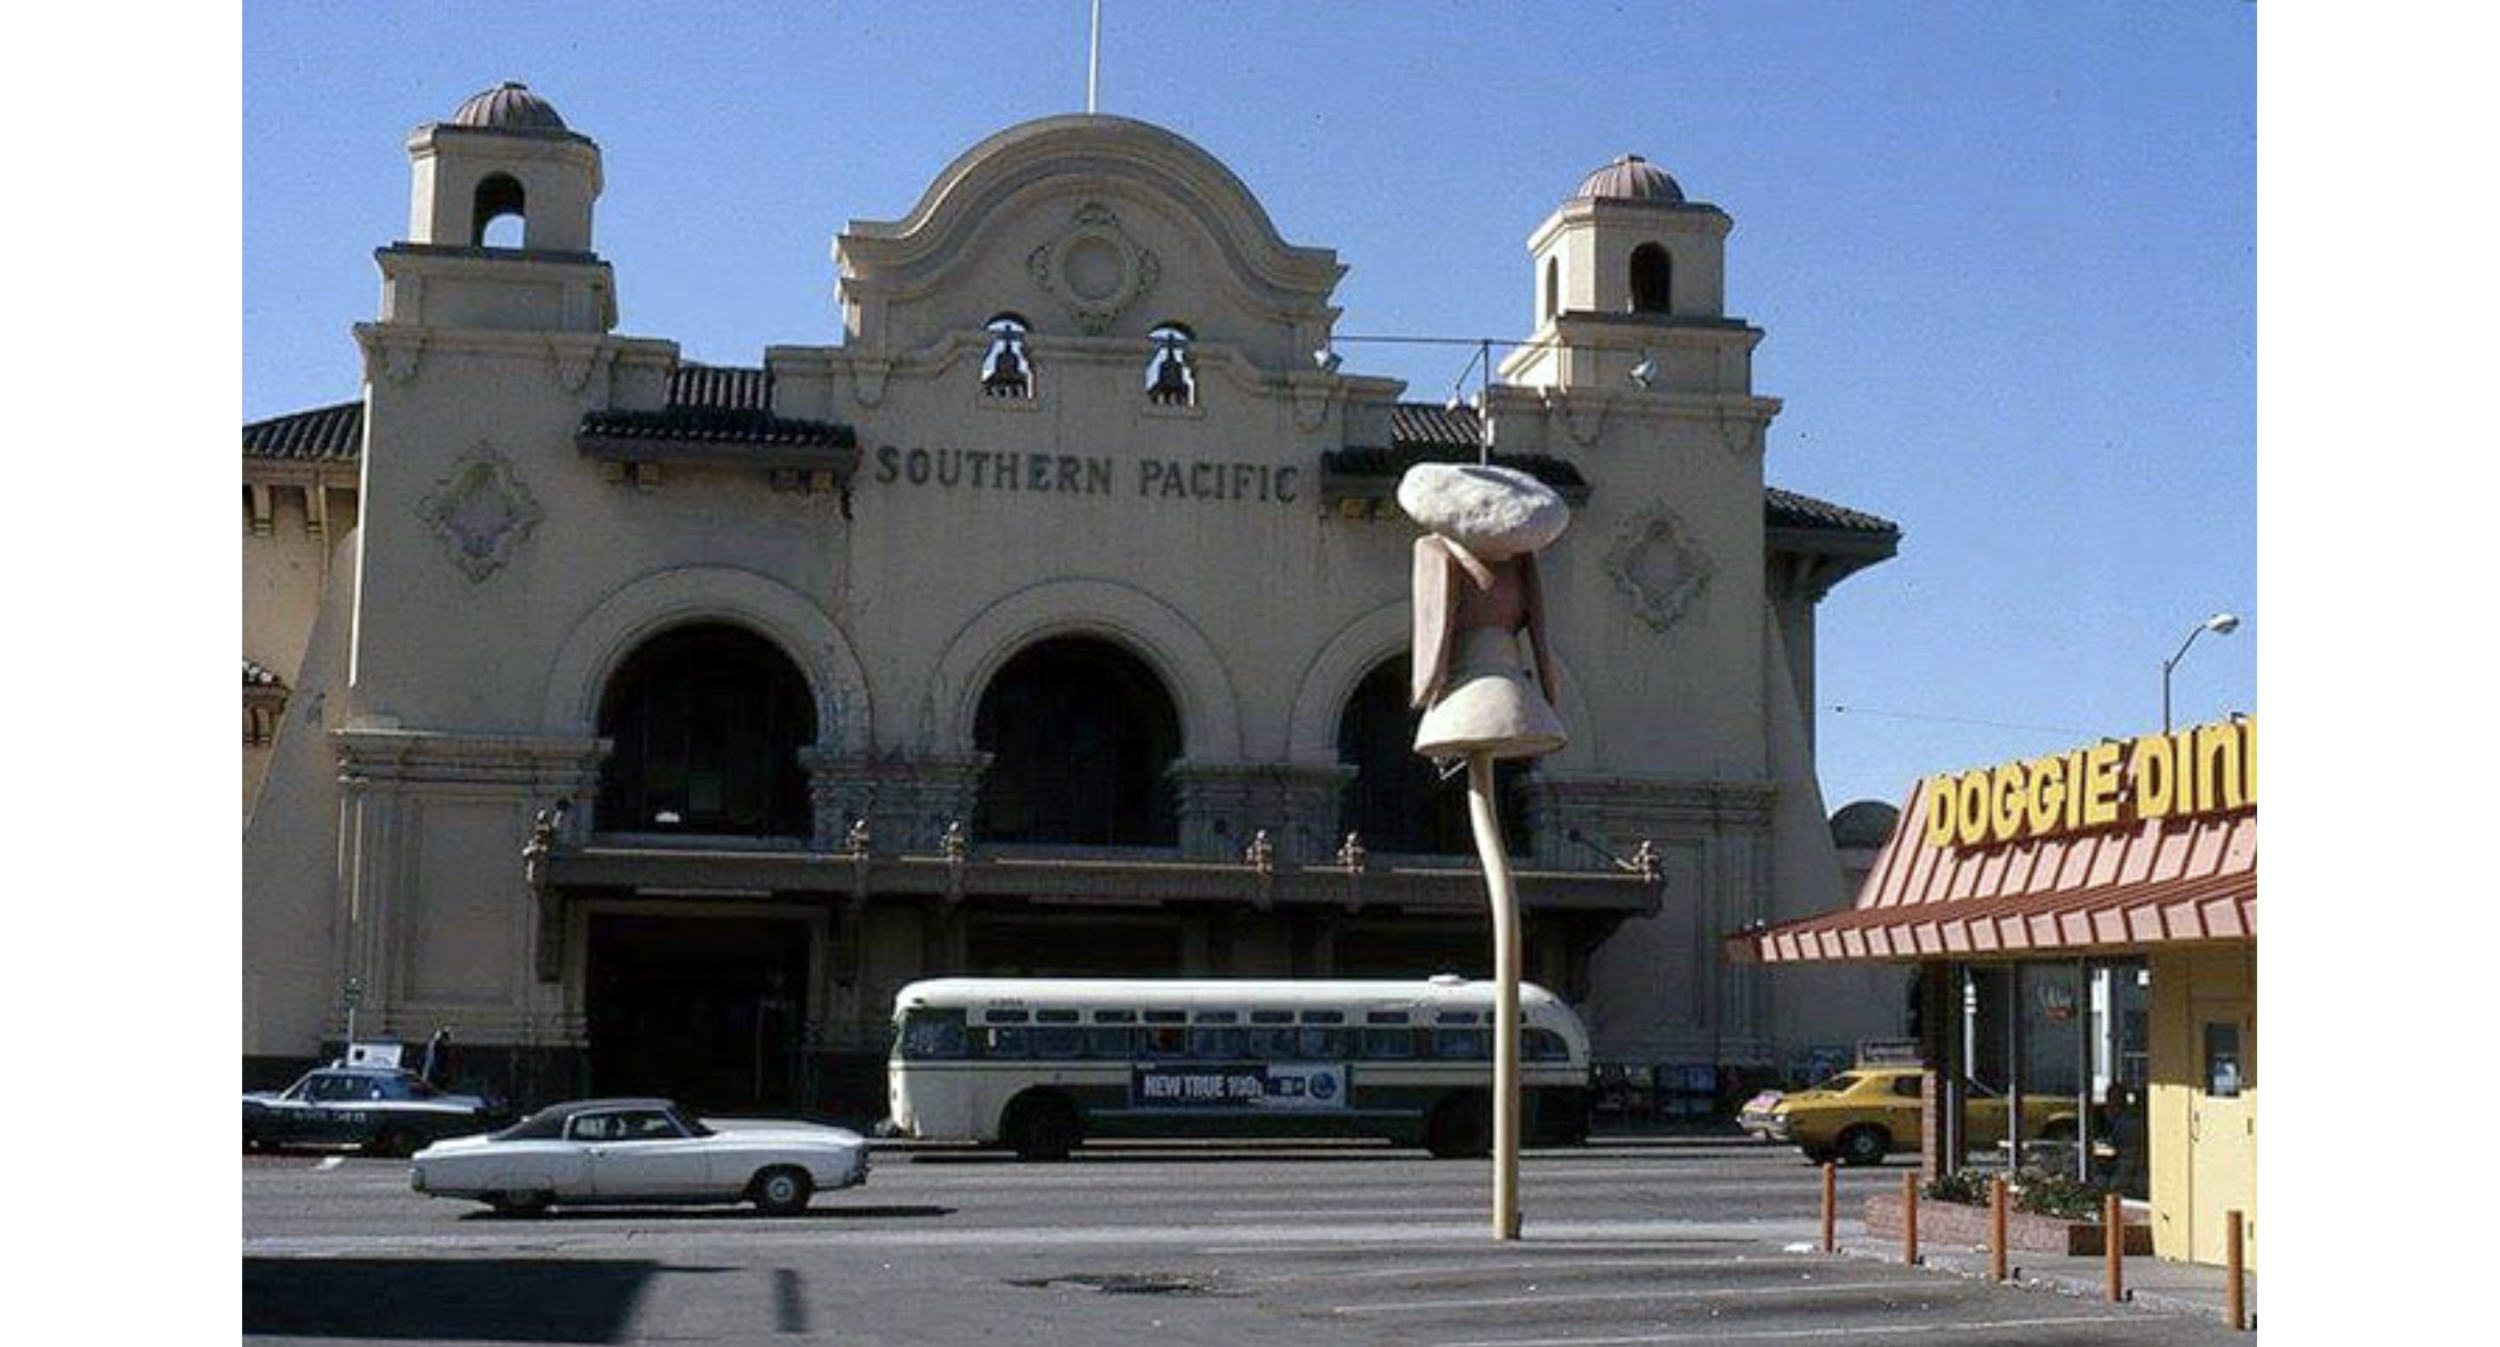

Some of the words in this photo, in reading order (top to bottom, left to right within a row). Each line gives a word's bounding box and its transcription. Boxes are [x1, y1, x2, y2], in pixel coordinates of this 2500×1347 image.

[875, 444, 1113, 496] SOUTHERN
[1138, 458, 1299, 505] PACIFIC
[1926, 743, 2123, 849] DOGGIE
[1144, 1075, 1181, 1098] NEW
[1184, 1075, 1225, 1098] TRUE
